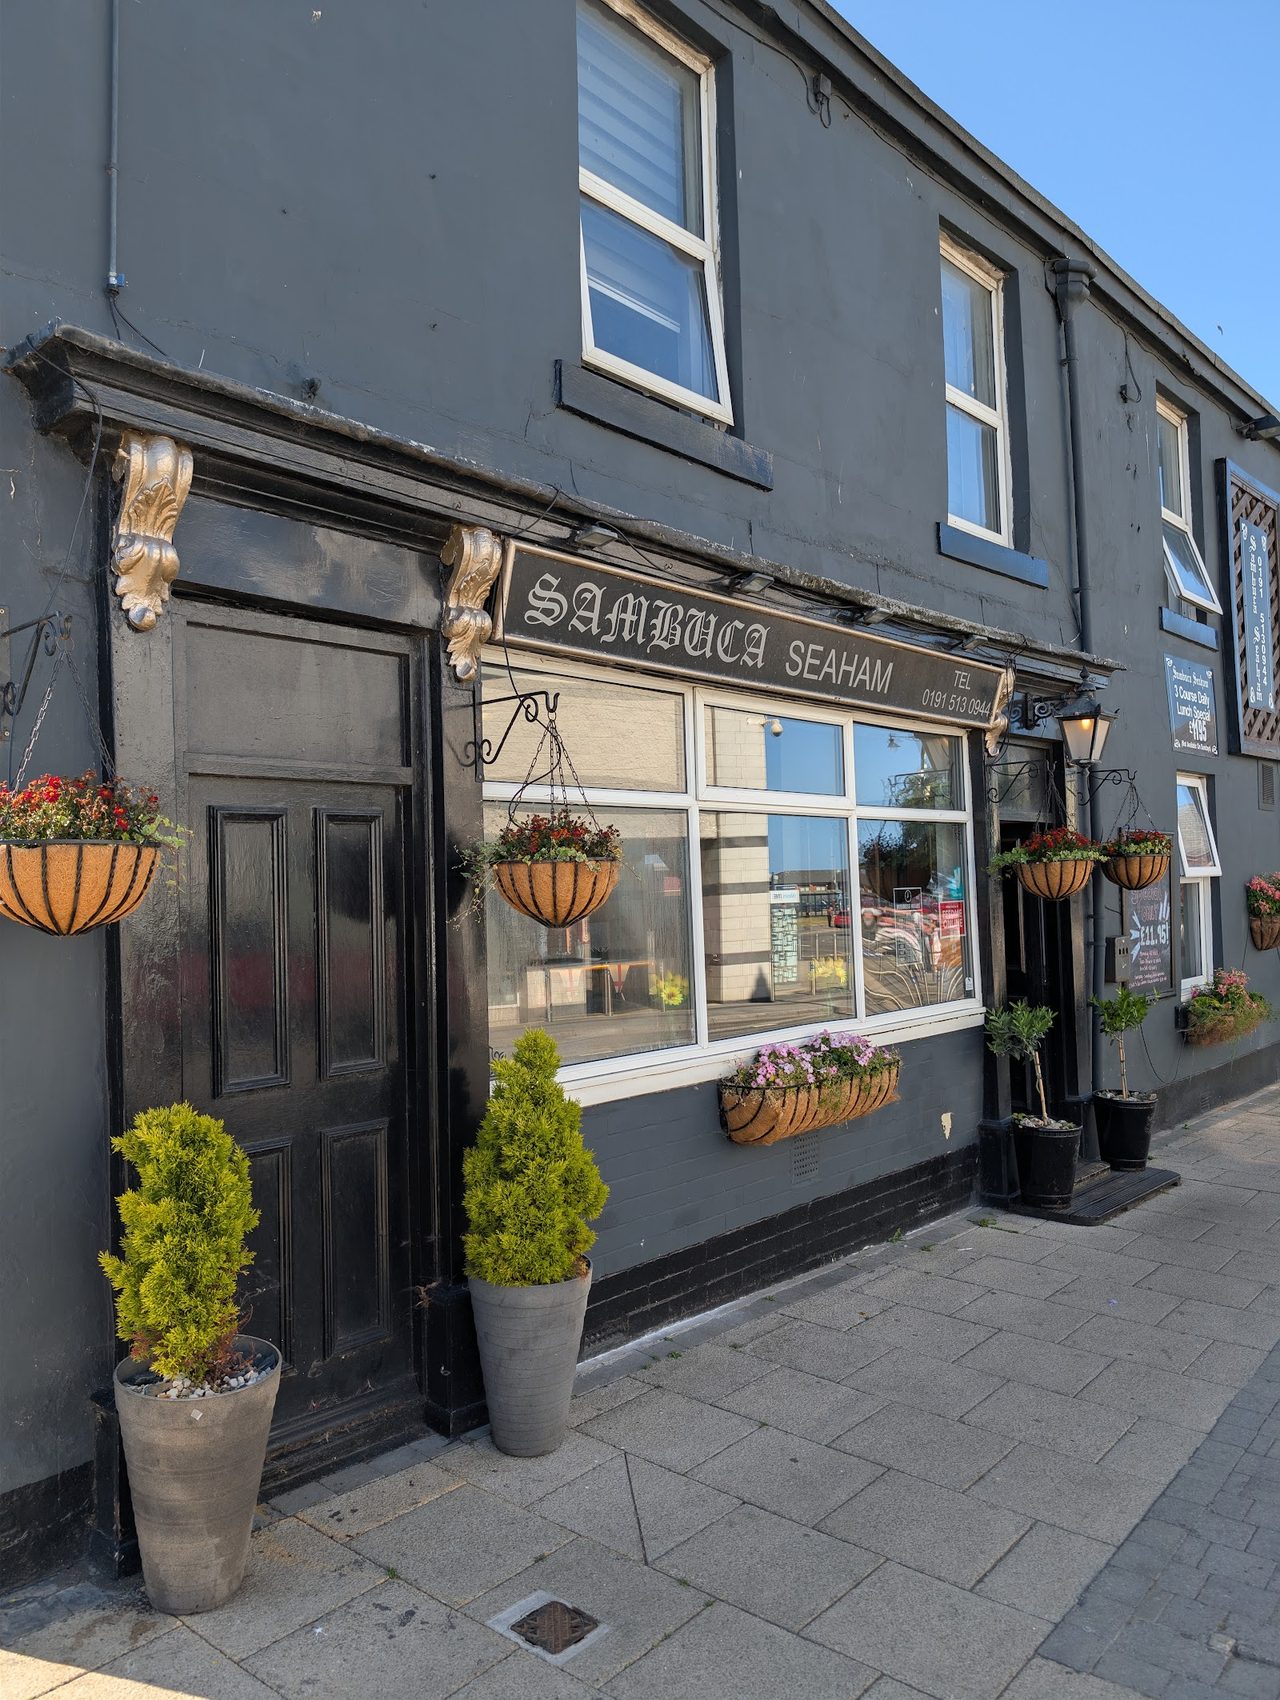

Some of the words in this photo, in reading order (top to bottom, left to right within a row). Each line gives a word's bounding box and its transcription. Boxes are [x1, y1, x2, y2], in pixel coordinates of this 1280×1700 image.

[524, 573, 771, 669] SAMBUCA
[785, 640, 894, 694] SEAHAM
[954, 670, 971, 690] TEL
[922, 689, 947, 709] 0191
[948, 694, 968, 713] 513
[968, 698, 991, 717] 0944
[1174, 684, 1179, 698] 3
[1179, 686, 1198, 703] Course
[1197, 691, 1210, 708] Daily
[1176, 701, 1193, 717] Lunch
[1193, 706, 1211, 721] Special
